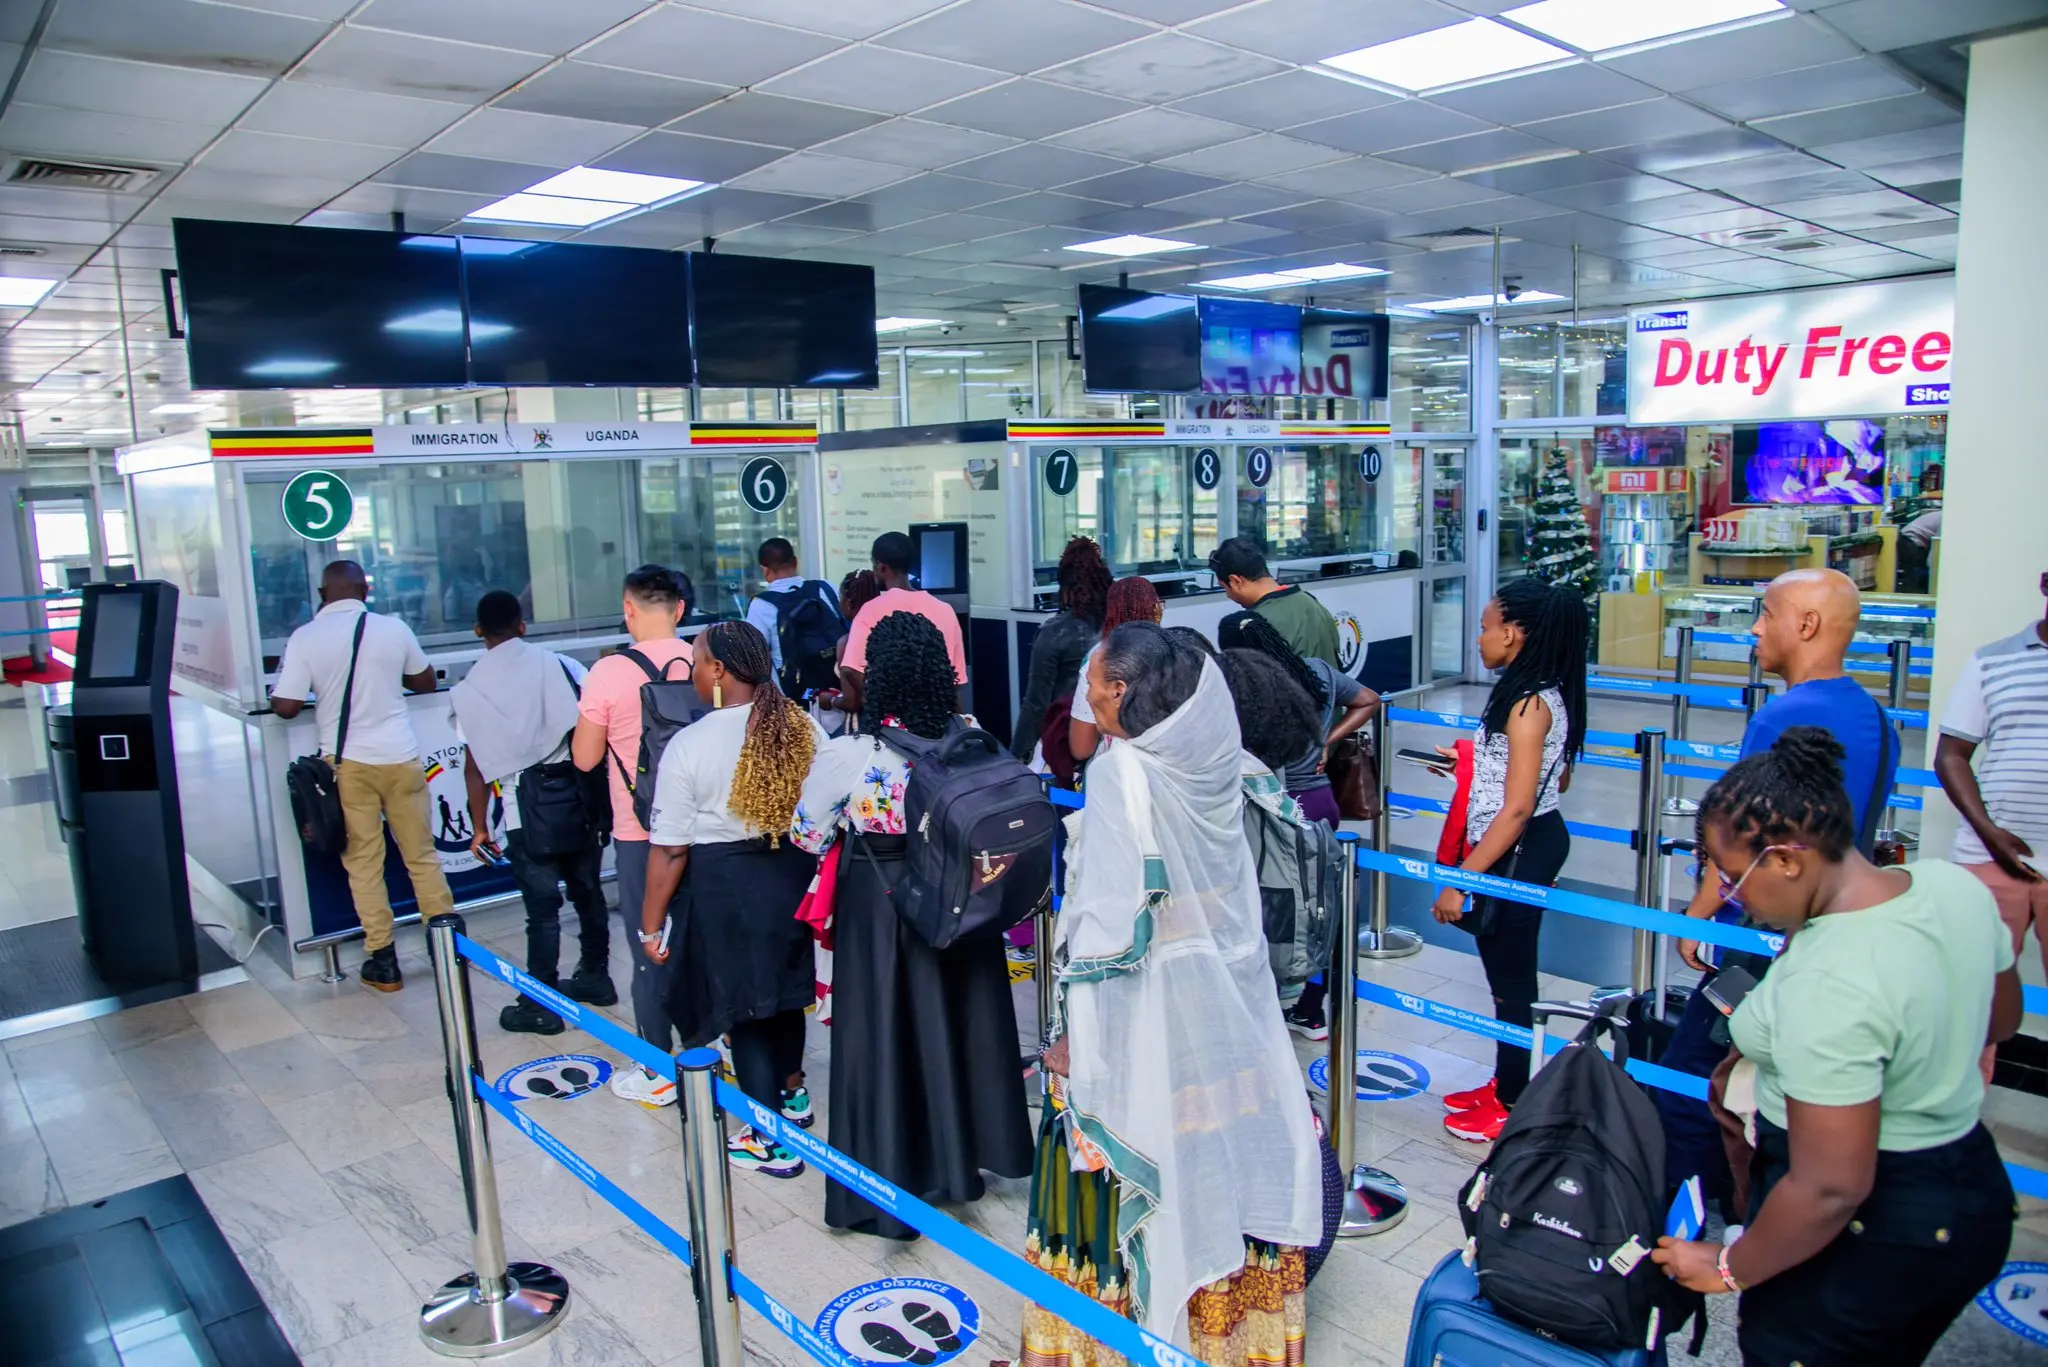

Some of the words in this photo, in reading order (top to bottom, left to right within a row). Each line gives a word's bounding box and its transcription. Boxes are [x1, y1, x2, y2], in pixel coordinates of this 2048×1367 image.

[1638, 313, 1688, 330] Transit
[1653, 335, 1790, 396] Duty
[1799, 325, 1951, 379] Free
[1911, 386, 1951, 403] Sho
[411, 432, 499, 446] IMMIGRATION
[585, 429, 640, 442] UGANDA
[1175, 424, 1212, 435] IMMIGRATION
[1247, 424, 1272, 435] UGANDA
[1053, 456, 1070, 489] 7
[1201, 454, 1215, 485] 8
[1253, 453, 1267, 483] 9
[1363, 453, 1380, 477] 10
[753, 464, 776, 504] 6
[306, 481, 334, 530] 5
[1434, 866, 1461, 879] Uganda
[1462, 871, 1479, 882] Civil
[1480, 875, 1511, 889] Aviation
[1511, 882, 1548, 898] Authority
[1430, 1003, 1457, 1018] Uganda
[1457, 1010, 1474, 1022] Civil
[1474, 1015, 1504, 1031] Aviation
[1505, 1024, 1533, 1039] Authori
[781, 1121, 809, 1147] Uganda
[809, 1139, 827, 1158] Civil
[827, 1150, 859, 1177] Aviation
[858, 1170, 897, 1201] Authority
[838, 1284, 880, 1310] SOCIAL
[882, 1278, 950, 1294] DISTANCE
